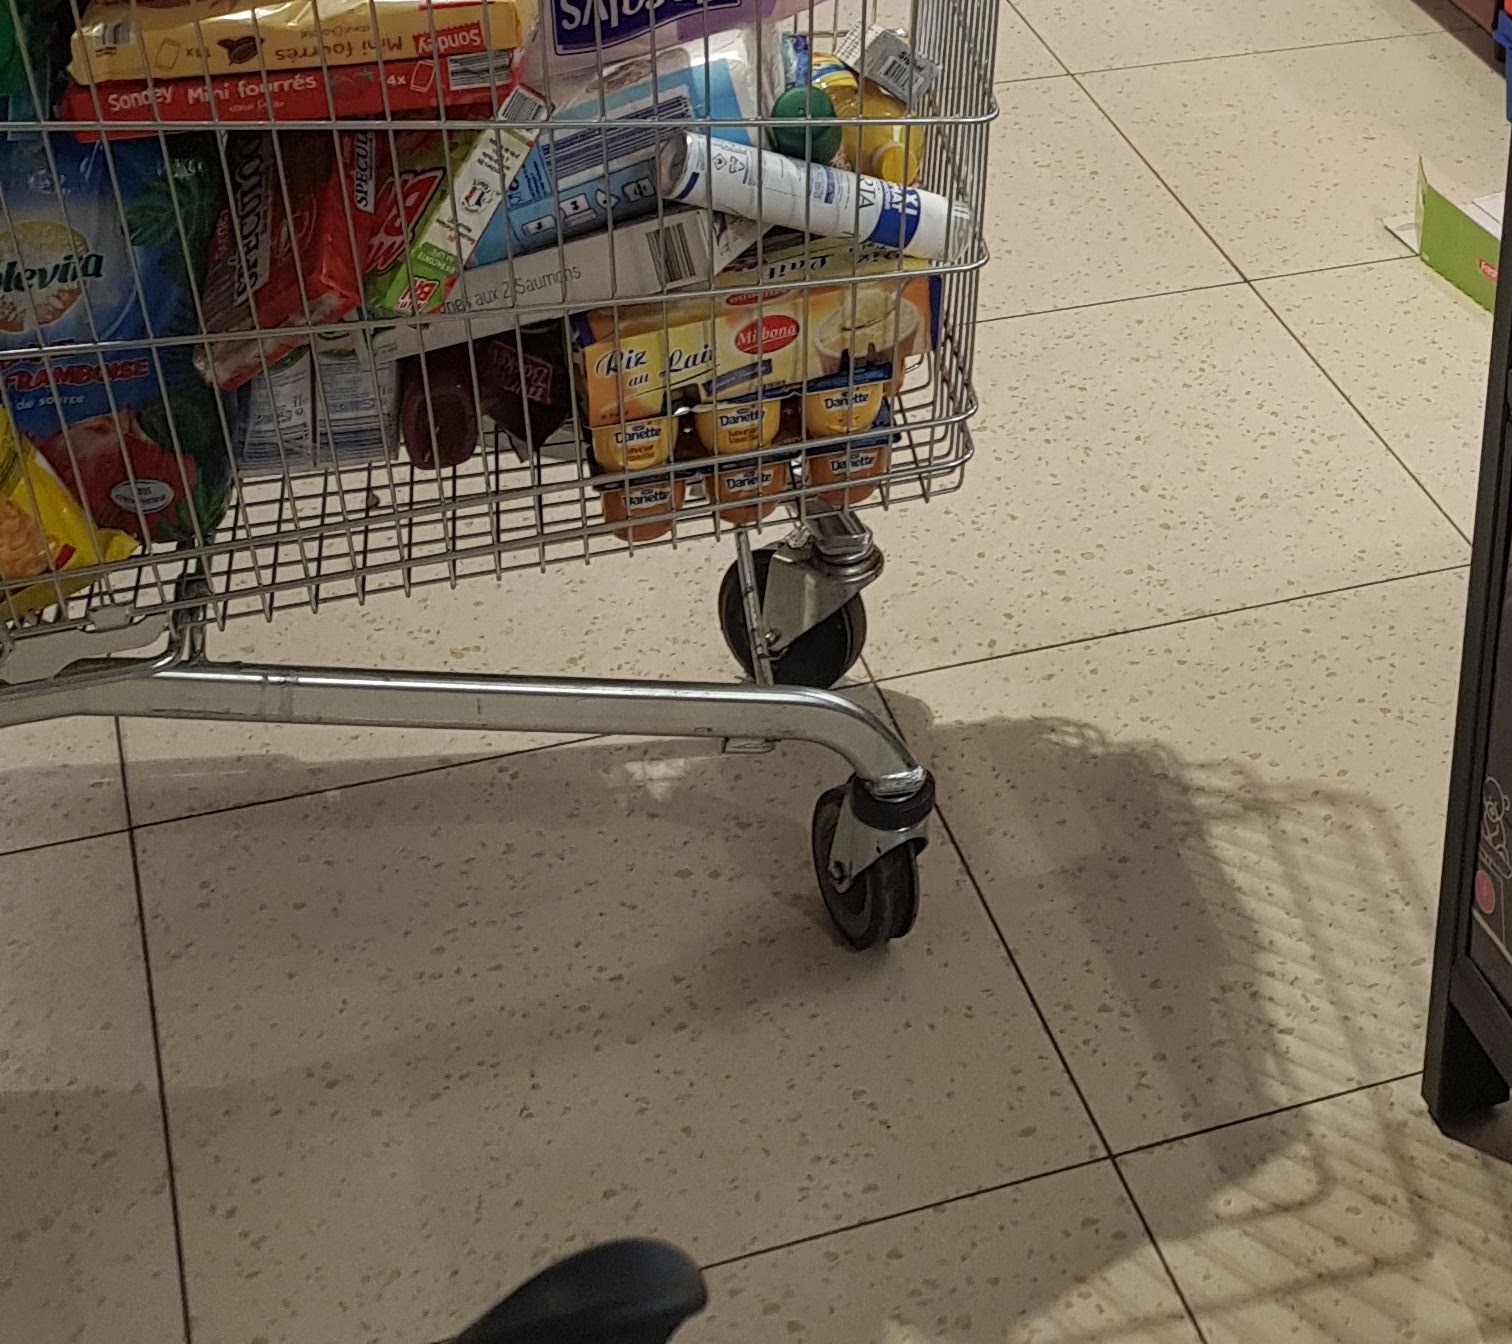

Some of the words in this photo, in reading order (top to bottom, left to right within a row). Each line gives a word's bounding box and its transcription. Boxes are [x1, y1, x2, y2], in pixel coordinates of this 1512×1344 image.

[238, 74, 317, 98] fourrés
[386, 74, 406, 88] 4x
[0, 252, 104, 293] levita
[475, 290, 498, 308] aux
[515, 265, 582, 295] Saumons
[596, 348, 647, 377] Riz
[628, 372, 649, 387] au
